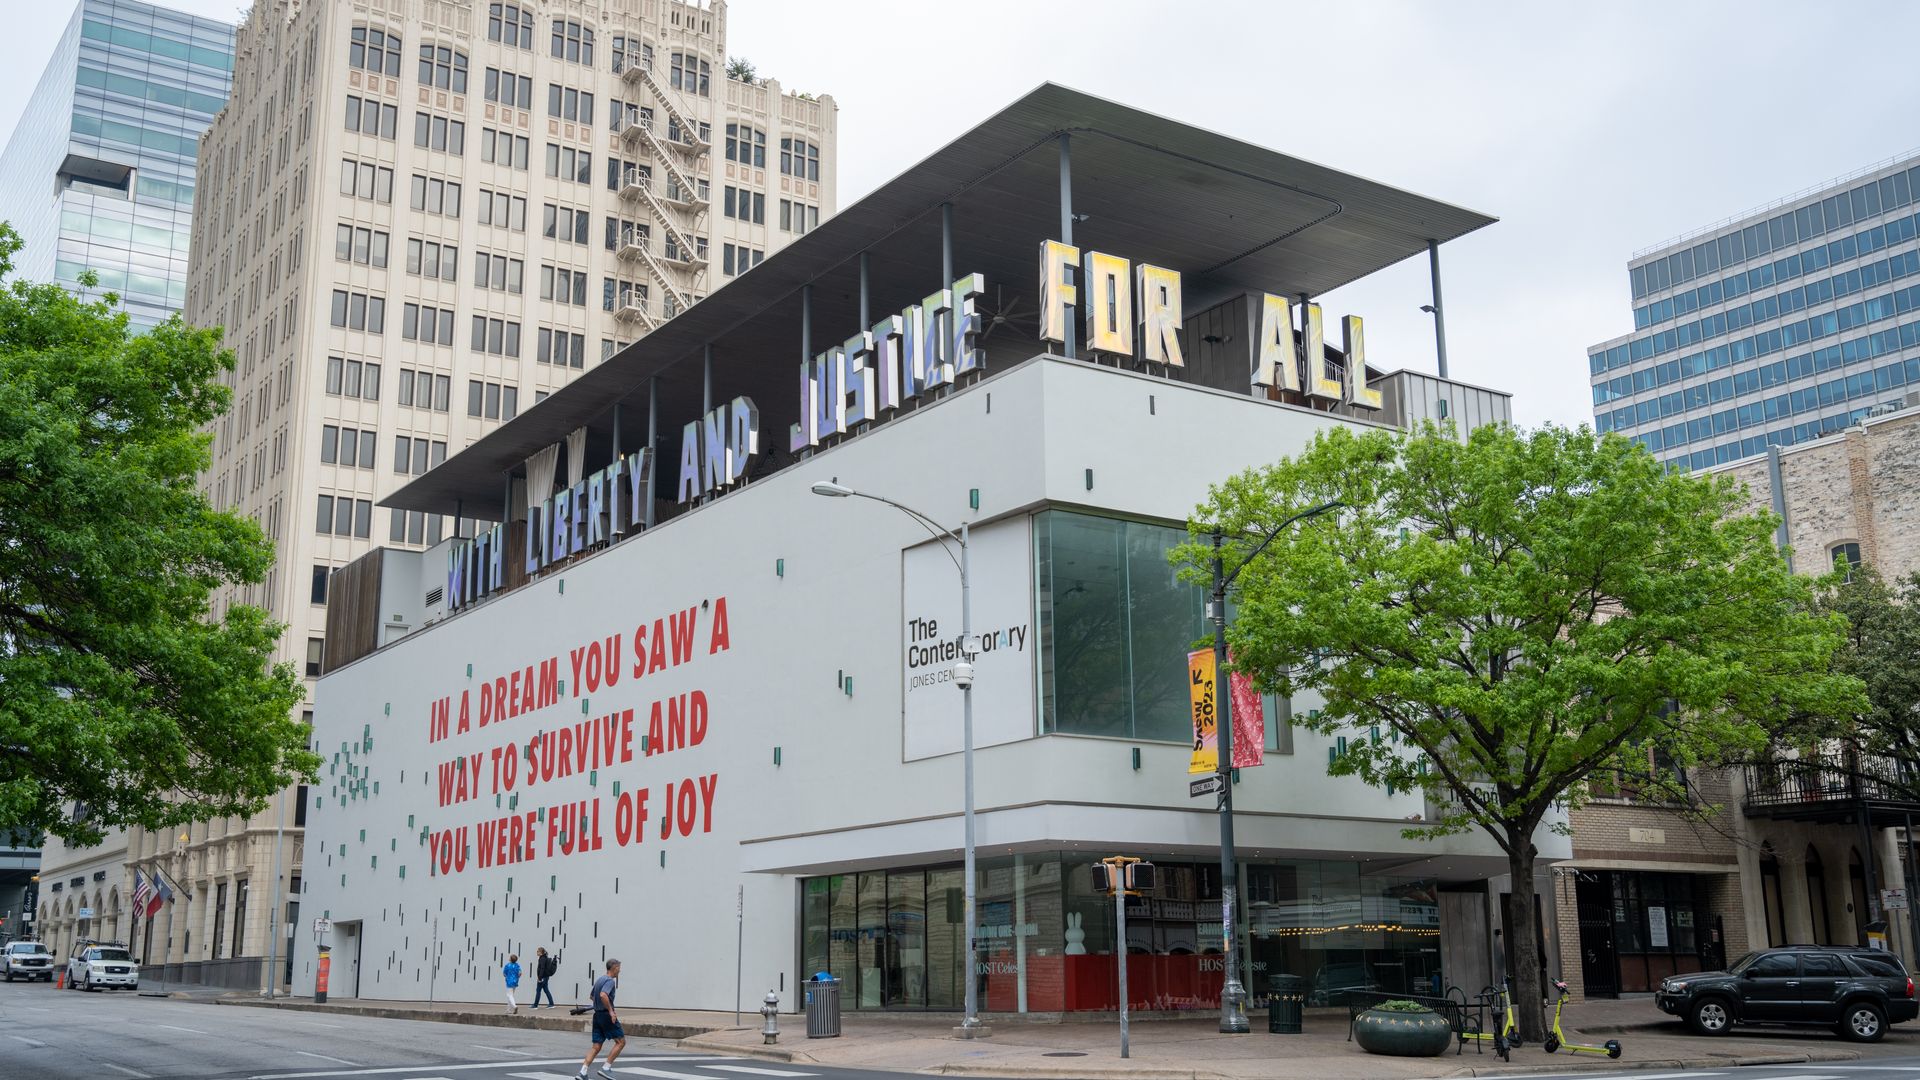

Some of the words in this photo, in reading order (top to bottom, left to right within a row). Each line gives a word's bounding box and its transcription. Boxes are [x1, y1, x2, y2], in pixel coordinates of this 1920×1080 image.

[1039, 239, 1184, 367] FOR
[1251, 292, 1382, 410] ALL
[447, 522, 508, 609] WITH
[526, 447, 653, 574] LIBERTY
[678, 395, 759, 504] AND
[790, 272, 985, 453] JUSTICE
[909, 617, 937, 642] The
[430, 697, 450, 743] IN
[458, 690, 469, 734] A
[479, 657, 557, 728] DREAM
[570, 634, 621, 697] YOU
[634, 606, 697, 679] SAW
[710, 597, 729, 655] A
[909, 673, 936, 692] JONES
[938, 669, 955, 683] CEN
[1203, 680, 1213, 727] 2023
[438, 752, 483, 808] WAY
[492, 742, 517, 794] TO
[528, 708, 633, 786] SURVIVE
[646, 690, 708, 757] AND
[1192, 784, 1202, 793] ONE
[1203, 781, 1215, 790] WAY
[429, 826, 468, 876] YOU
[477, 811, 537, 869] WERE
[547, 797, 602, 857] FULL
[616, 788, 649, 847] OF
[661, 774, 718, 840] JOY
[1199, 958, 1223, 971] HOS
[1240, 960, 1267, 971] eleste
